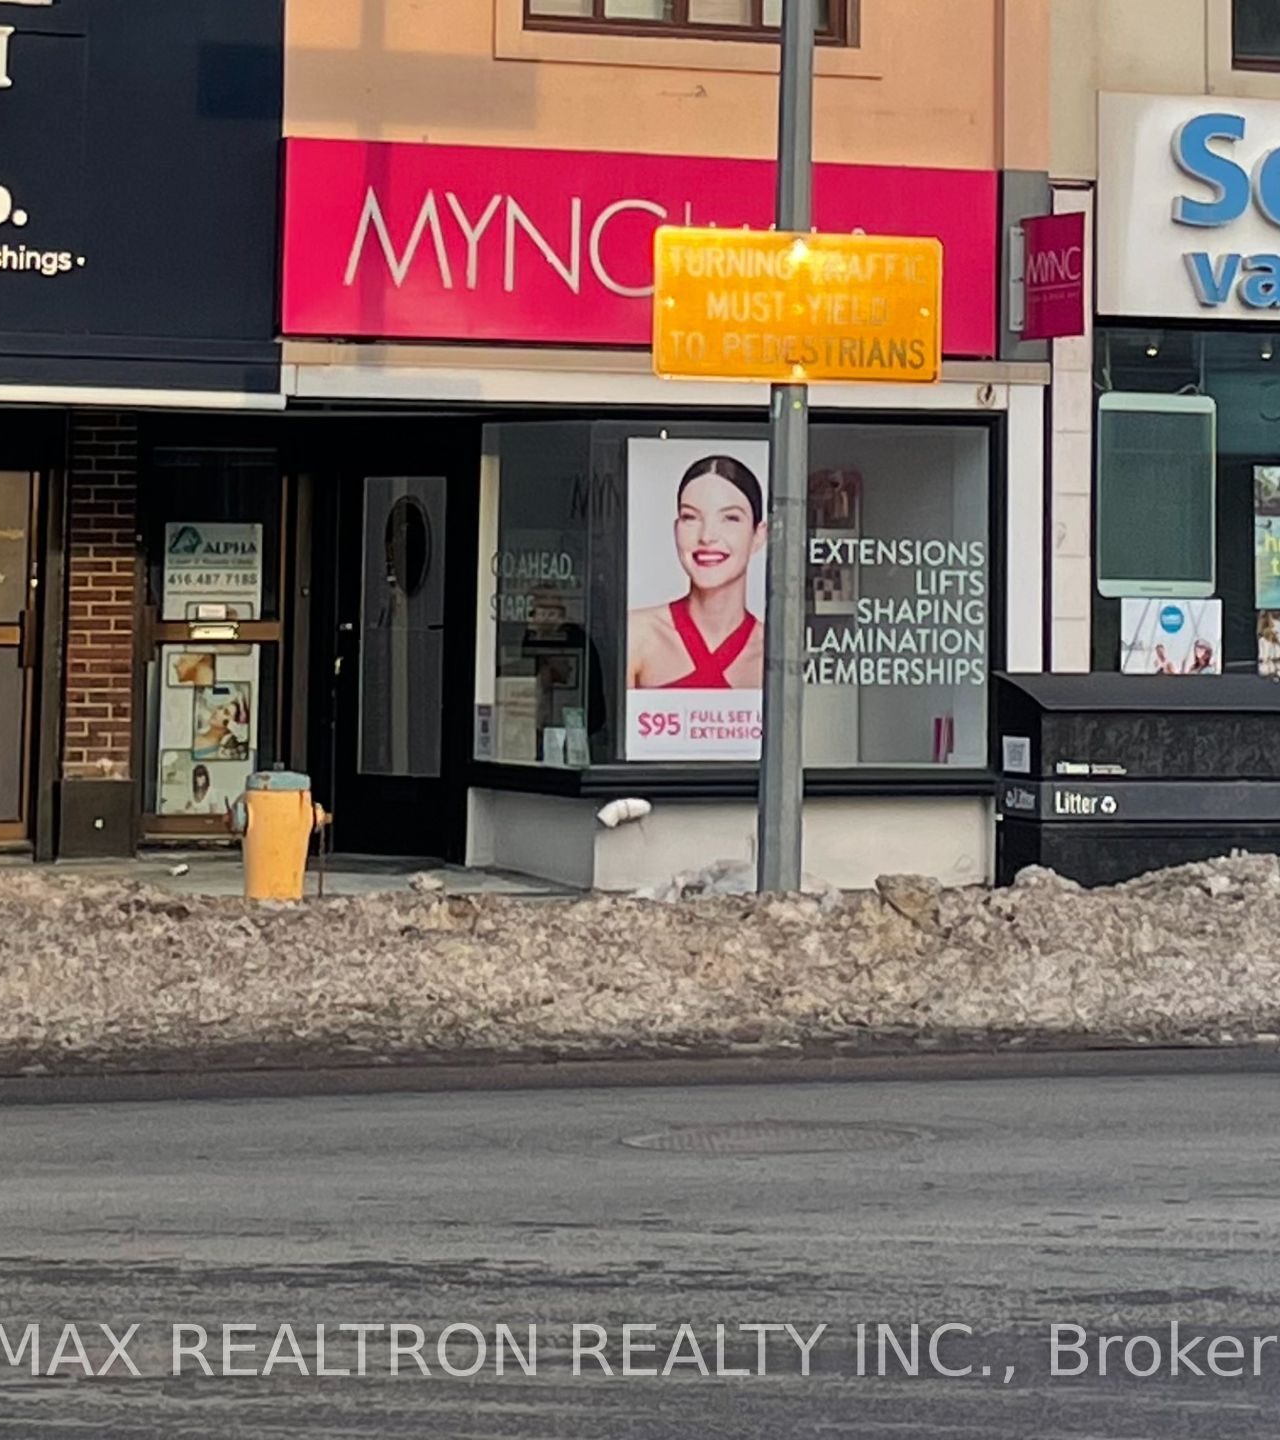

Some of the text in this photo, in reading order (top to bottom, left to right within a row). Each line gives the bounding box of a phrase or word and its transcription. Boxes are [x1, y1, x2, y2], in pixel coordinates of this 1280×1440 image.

[343, 184, 667, 298] MYNC
[670, 245, 926, 285] TURNING TRAFFIC
[707, 291, 887, 327] MUST YIELD
[670, 330, 926, 370] TO PEDESTRIANS
[203, 541, 258, 555] ALPHA
[809, 538, 985, 567] EXTENSIONS
[916, 569, 985, 596] LIFTS
[857, 598, 985, 625] SHAPING
[806, 627, 985, 654] LAMINATION
[637, 712, 681, 737] $95
[690, 710, 724, 723] FULL
[728, 710, 752, 723] SET
[690, 727, 763, 740] EXTENSIO
[1055, 790, 1098, 814] Litter
